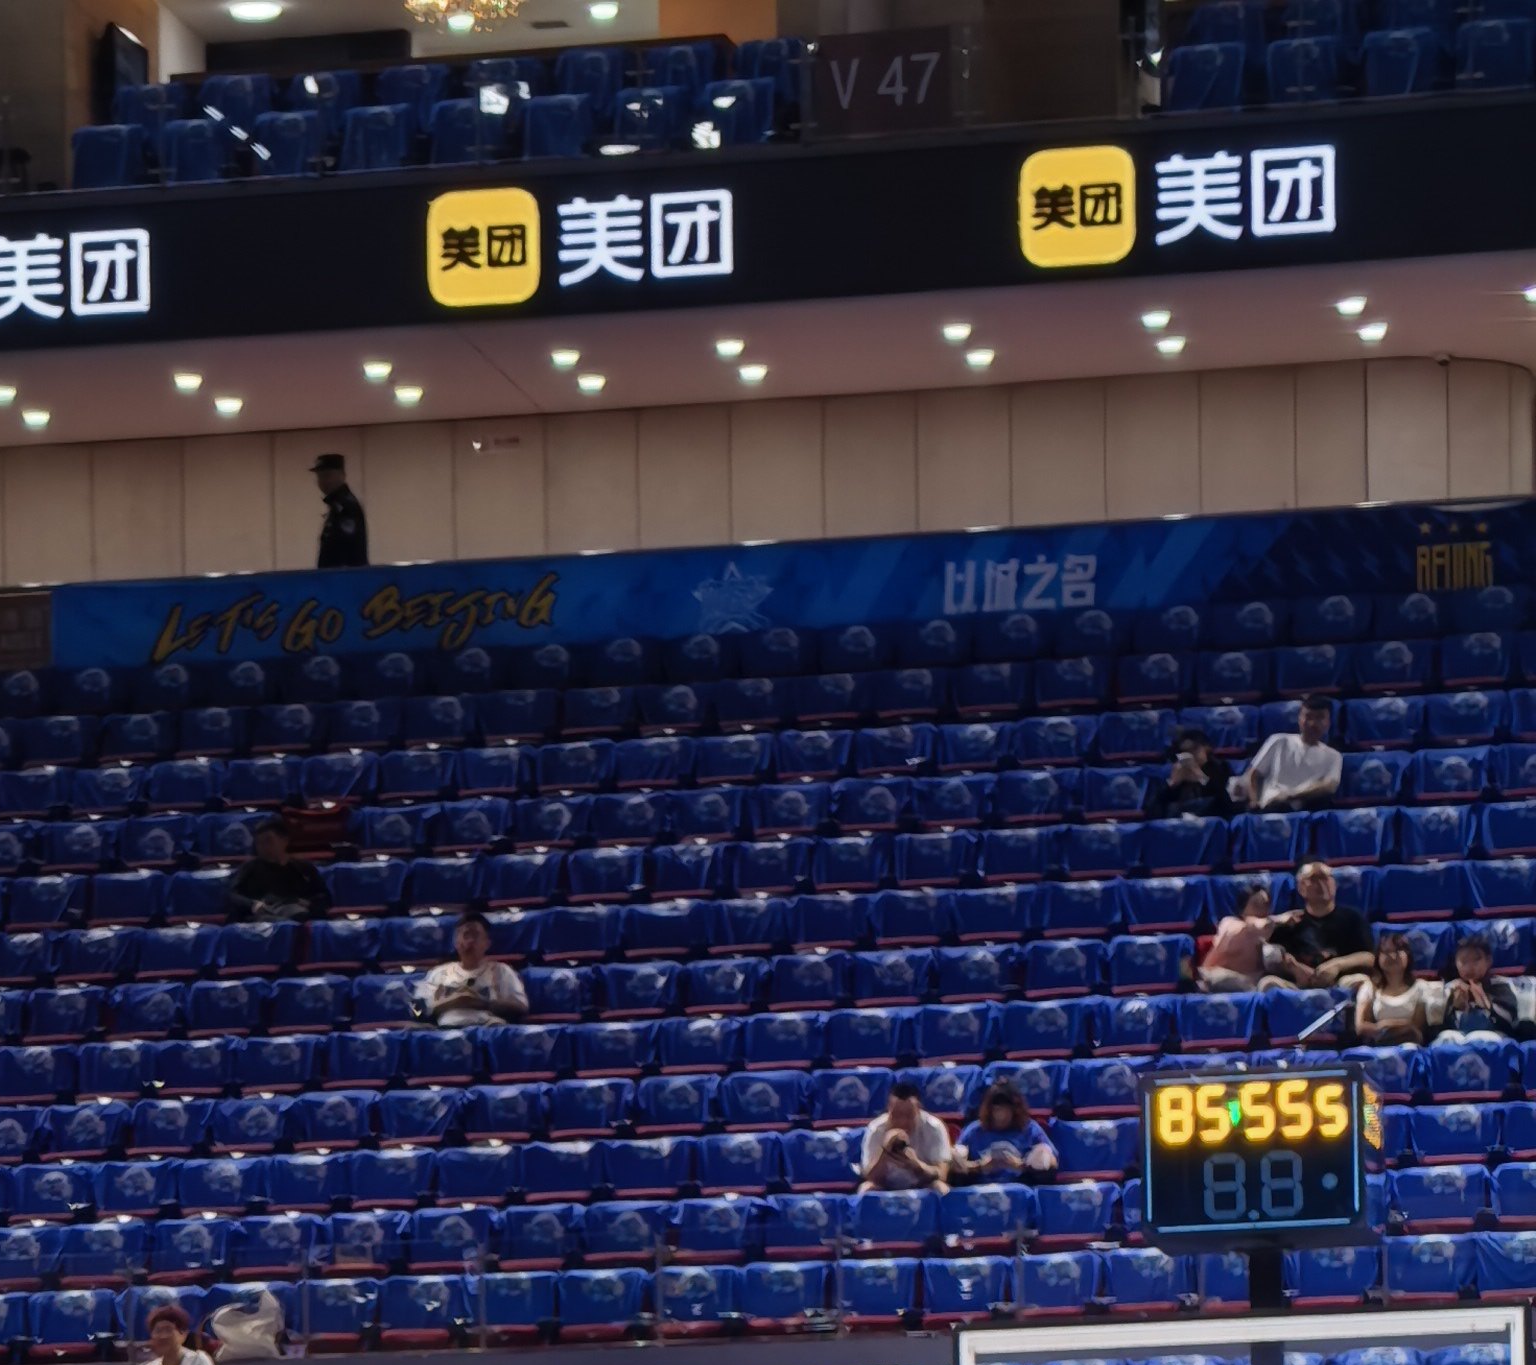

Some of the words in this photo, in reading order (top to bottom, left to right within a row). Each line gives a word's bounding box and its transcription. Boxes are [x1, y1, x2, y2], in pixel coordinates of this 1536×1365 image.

[830, 58, 859, 110] V
[876, 52, 941, 105] 47
[1032, 183, 1123, 232] 美团
[1155, 144, 1336, 246] 美团
[441, 224, 528, 272] 美团
[557, 188, 734, 287] 美团
[281, 598, 345, 654] GO
[362, 572, 561, 652] BEIJING
